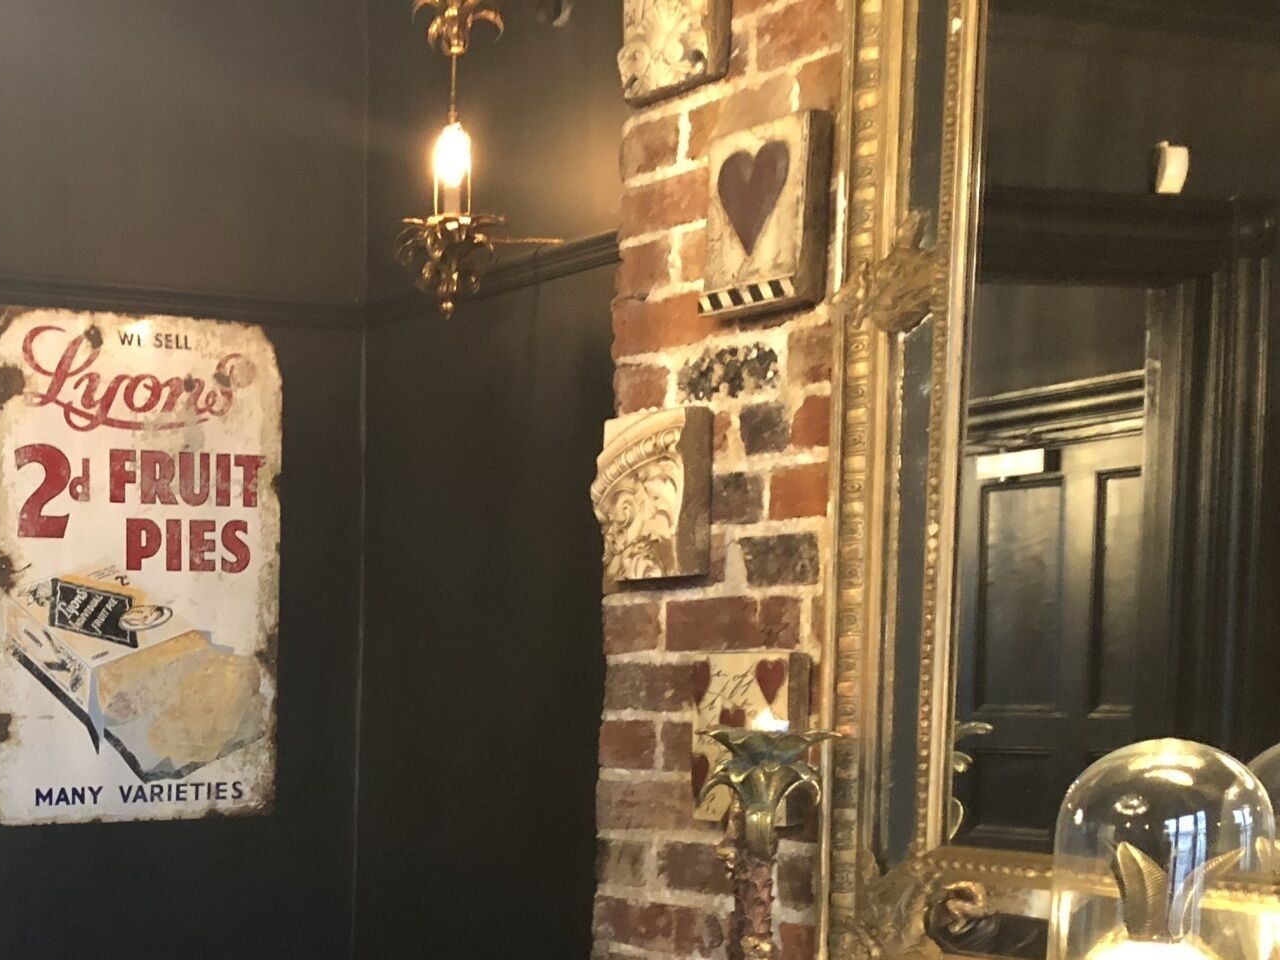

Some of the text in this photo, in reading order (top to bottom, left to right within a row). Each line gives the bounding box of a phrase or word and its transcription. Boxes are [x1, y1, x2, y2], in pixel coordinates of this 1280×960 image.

[153, 332, 192, 350] SELL
[21, 325, 252, 432] Lyons
[14, 443, 266, 538] 2d FRUIT
[126, 518, 251, 573] PIES
[59, 586, 88, 619] Lyons
[35, 780, 244, 807] MANY VARIETIES
